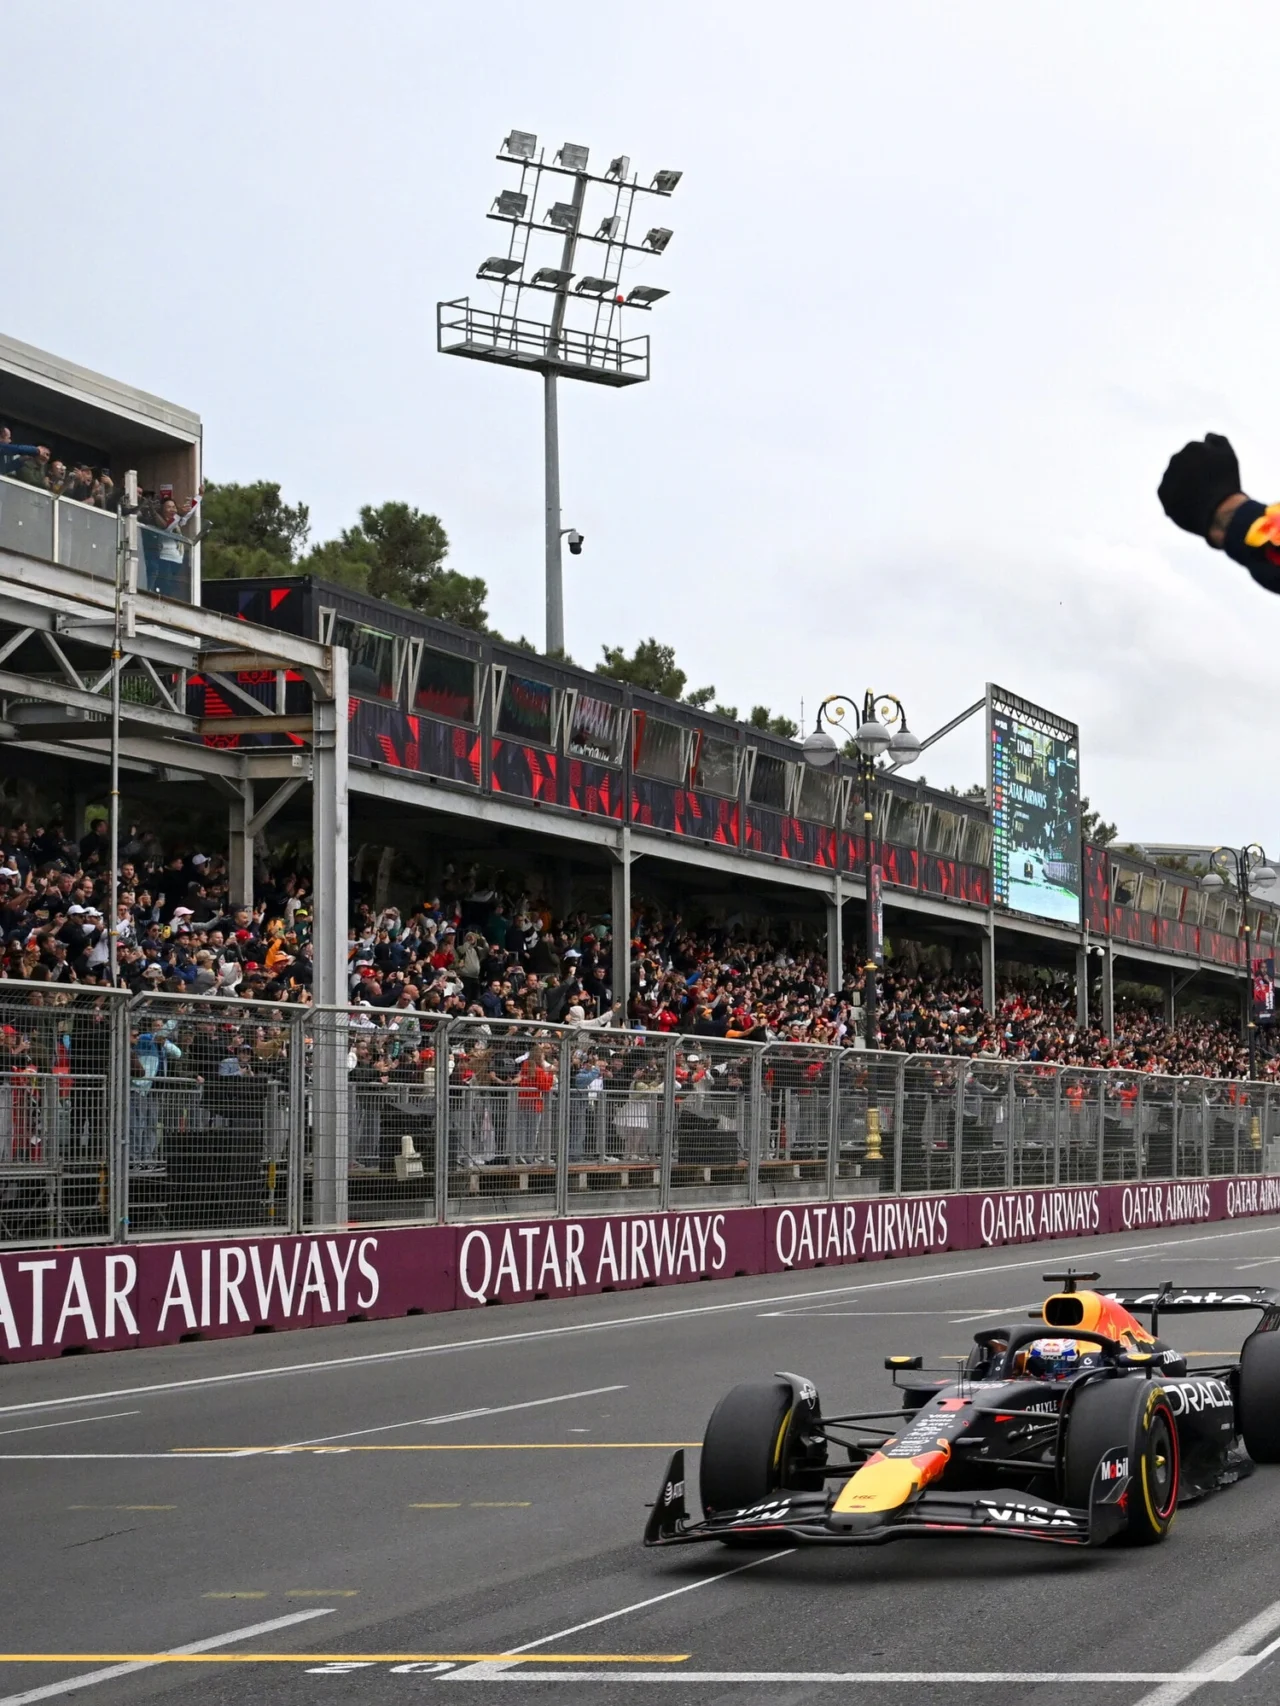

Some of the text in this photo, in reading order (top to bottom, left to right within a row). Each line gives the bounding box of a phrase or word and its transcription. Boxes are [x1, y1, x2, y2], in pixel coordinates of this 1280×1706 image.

[980, 1190, 1099, 1245] QATAR AIRWAYS
[1122, 1183, 1210, 1229] QATAR AIRWAYS
[1226, 1180, 1259, 1218] QATAR
[776, 1199, 948, 1266] QATAR AIRWAYS
[460, 1214, 727, 1304] QATAR AIRWAYS
[157, 1237, 380, 1332] AIRWAYS
[1025, 1399, 1059, 1413] CARLYLE
[1101, 1456, 1129, 1481] Mobil
[979, 1499, 1078, 1526] VISA
